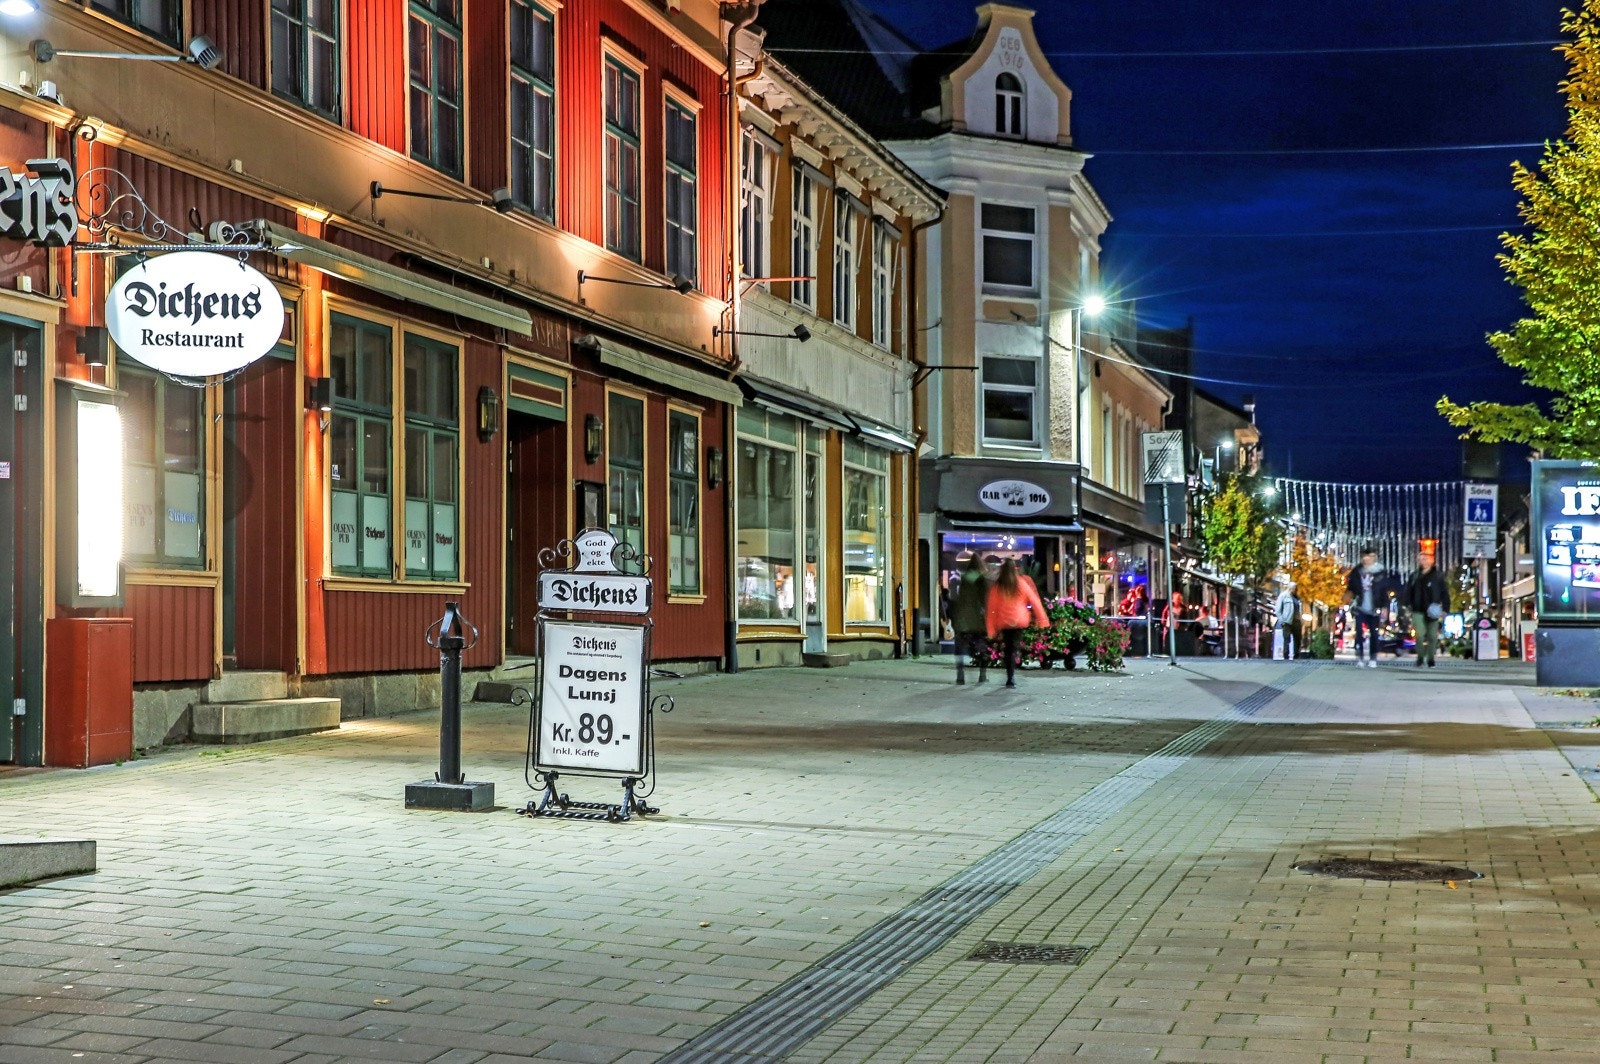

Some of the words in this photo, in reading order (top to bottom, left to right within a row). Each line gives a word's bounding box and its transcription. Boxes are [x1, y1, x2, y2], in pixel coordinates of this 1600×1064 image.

[124, 281, 262, 327] Dickens
[141, 329, 245, 349] Restaurant
[982, 491, 1000, 500] BAR
[1029, 493, 1047, 503] 1016
[1470, 486, 1492, 495] Sone
[333, 523, 355, 533] OLSEN'S
[338, 533, 350, 543] PUB
[411, 539, 422, 549] PUB
[551, 579, 638, 607] Dickens
[572, 636, 617, 651] Dickens
[559, 664, 627, 682] Dagens
[568, 685, 616, 704] Lunsj
[553, 722, 574, 742] Kr.
[552, 747, 572, 756] Inkl.
[575, 749, 600, 757] Kaffe
